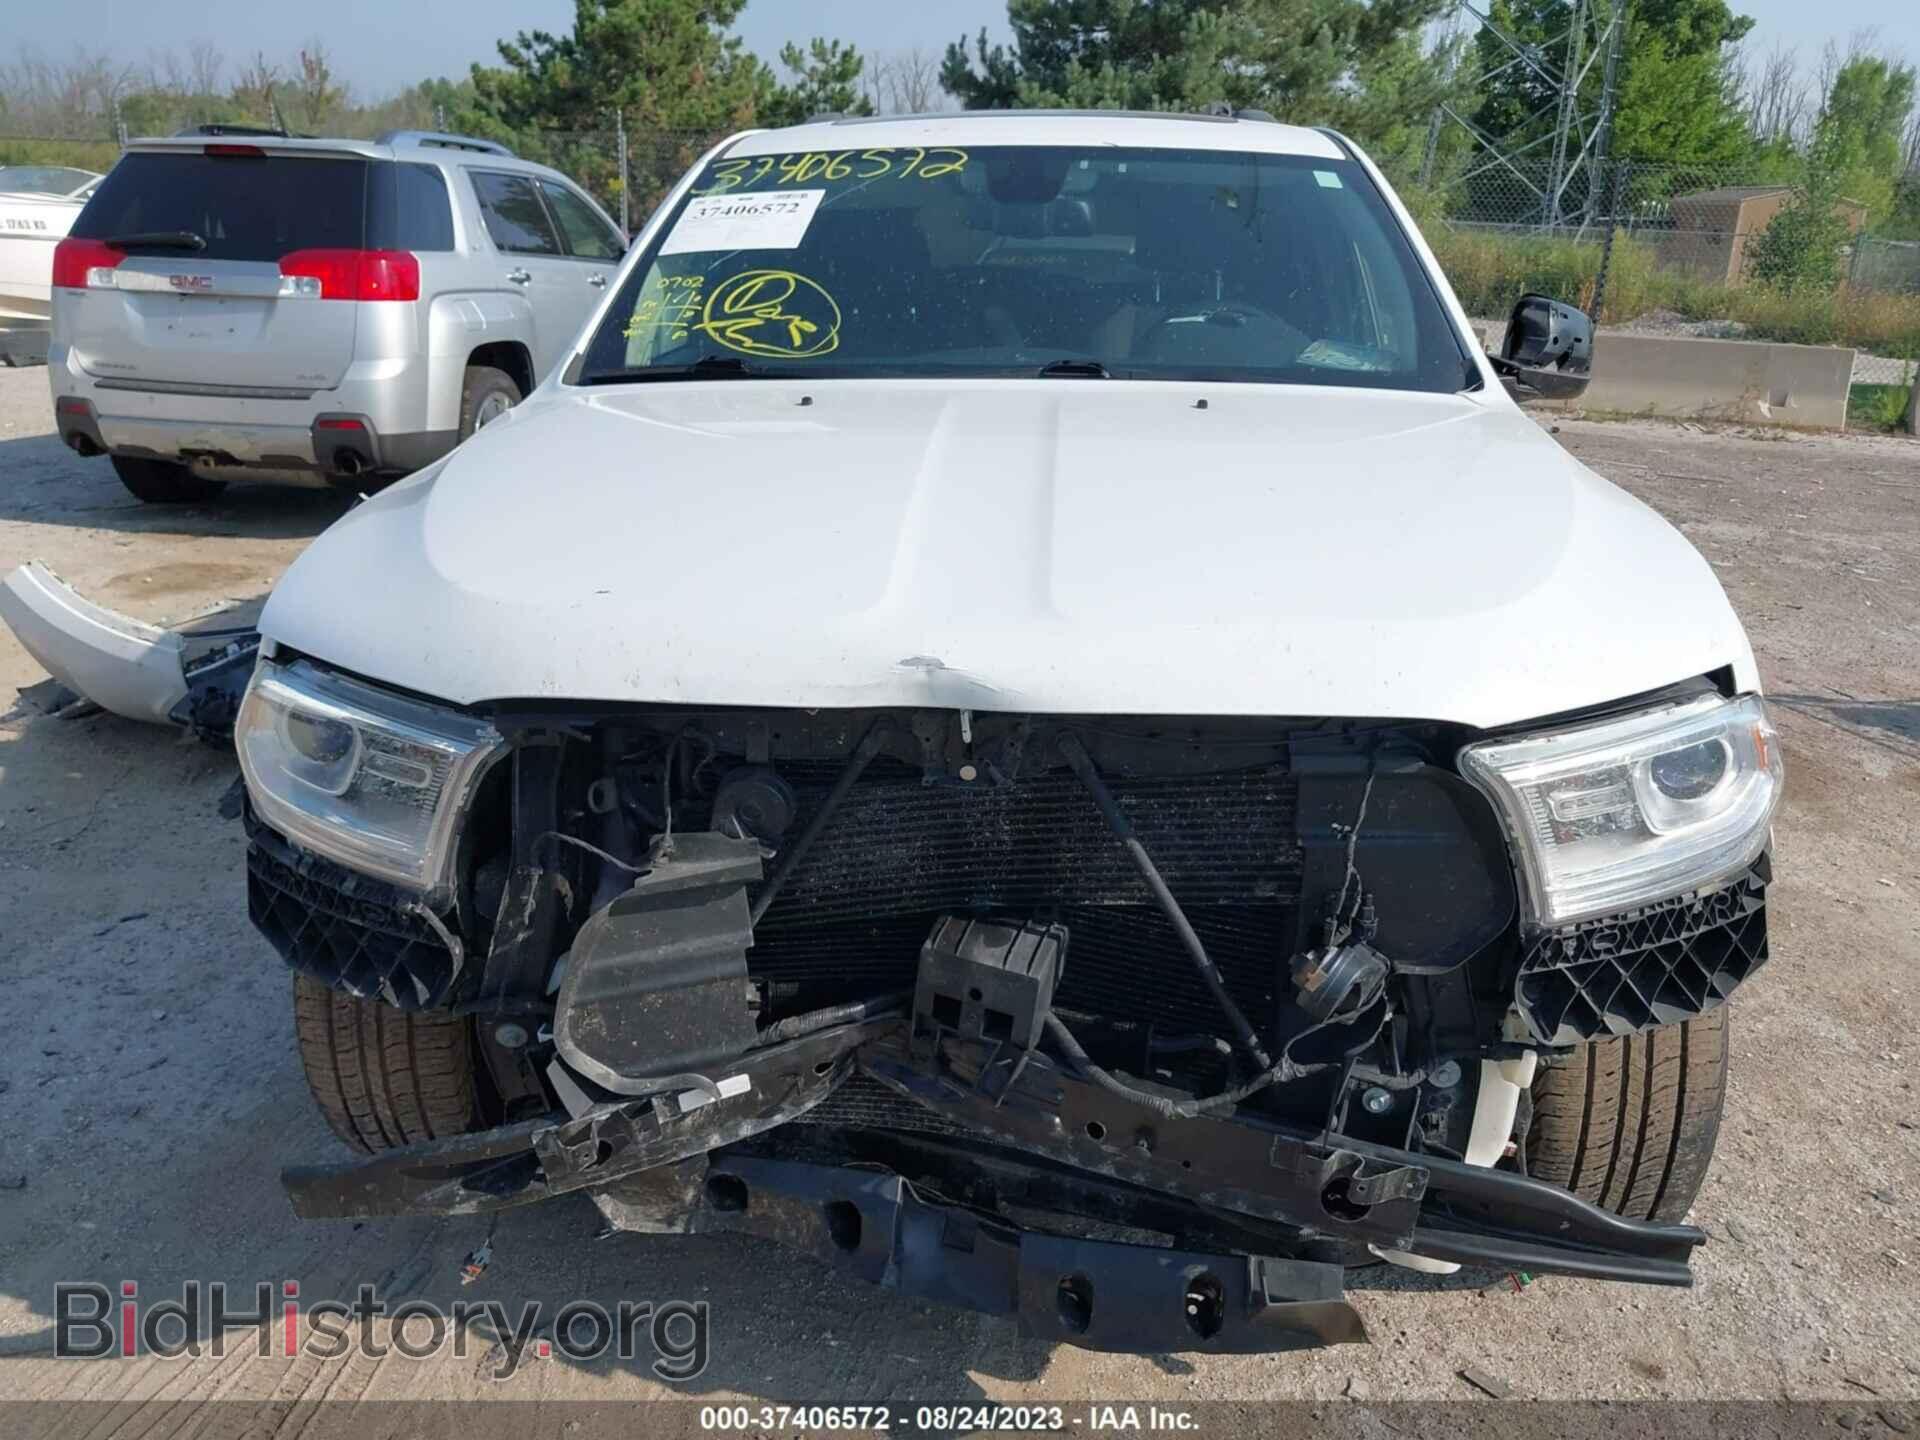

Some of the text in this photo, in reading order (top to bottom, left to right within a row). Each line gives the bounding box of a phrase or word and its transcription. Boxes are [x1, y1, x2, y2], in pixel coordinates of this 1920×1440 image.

[690, 146, 969, 194] 37406572
[692, 202, 801, 220] 37406572
[169, 275, 213, 289] GMC
